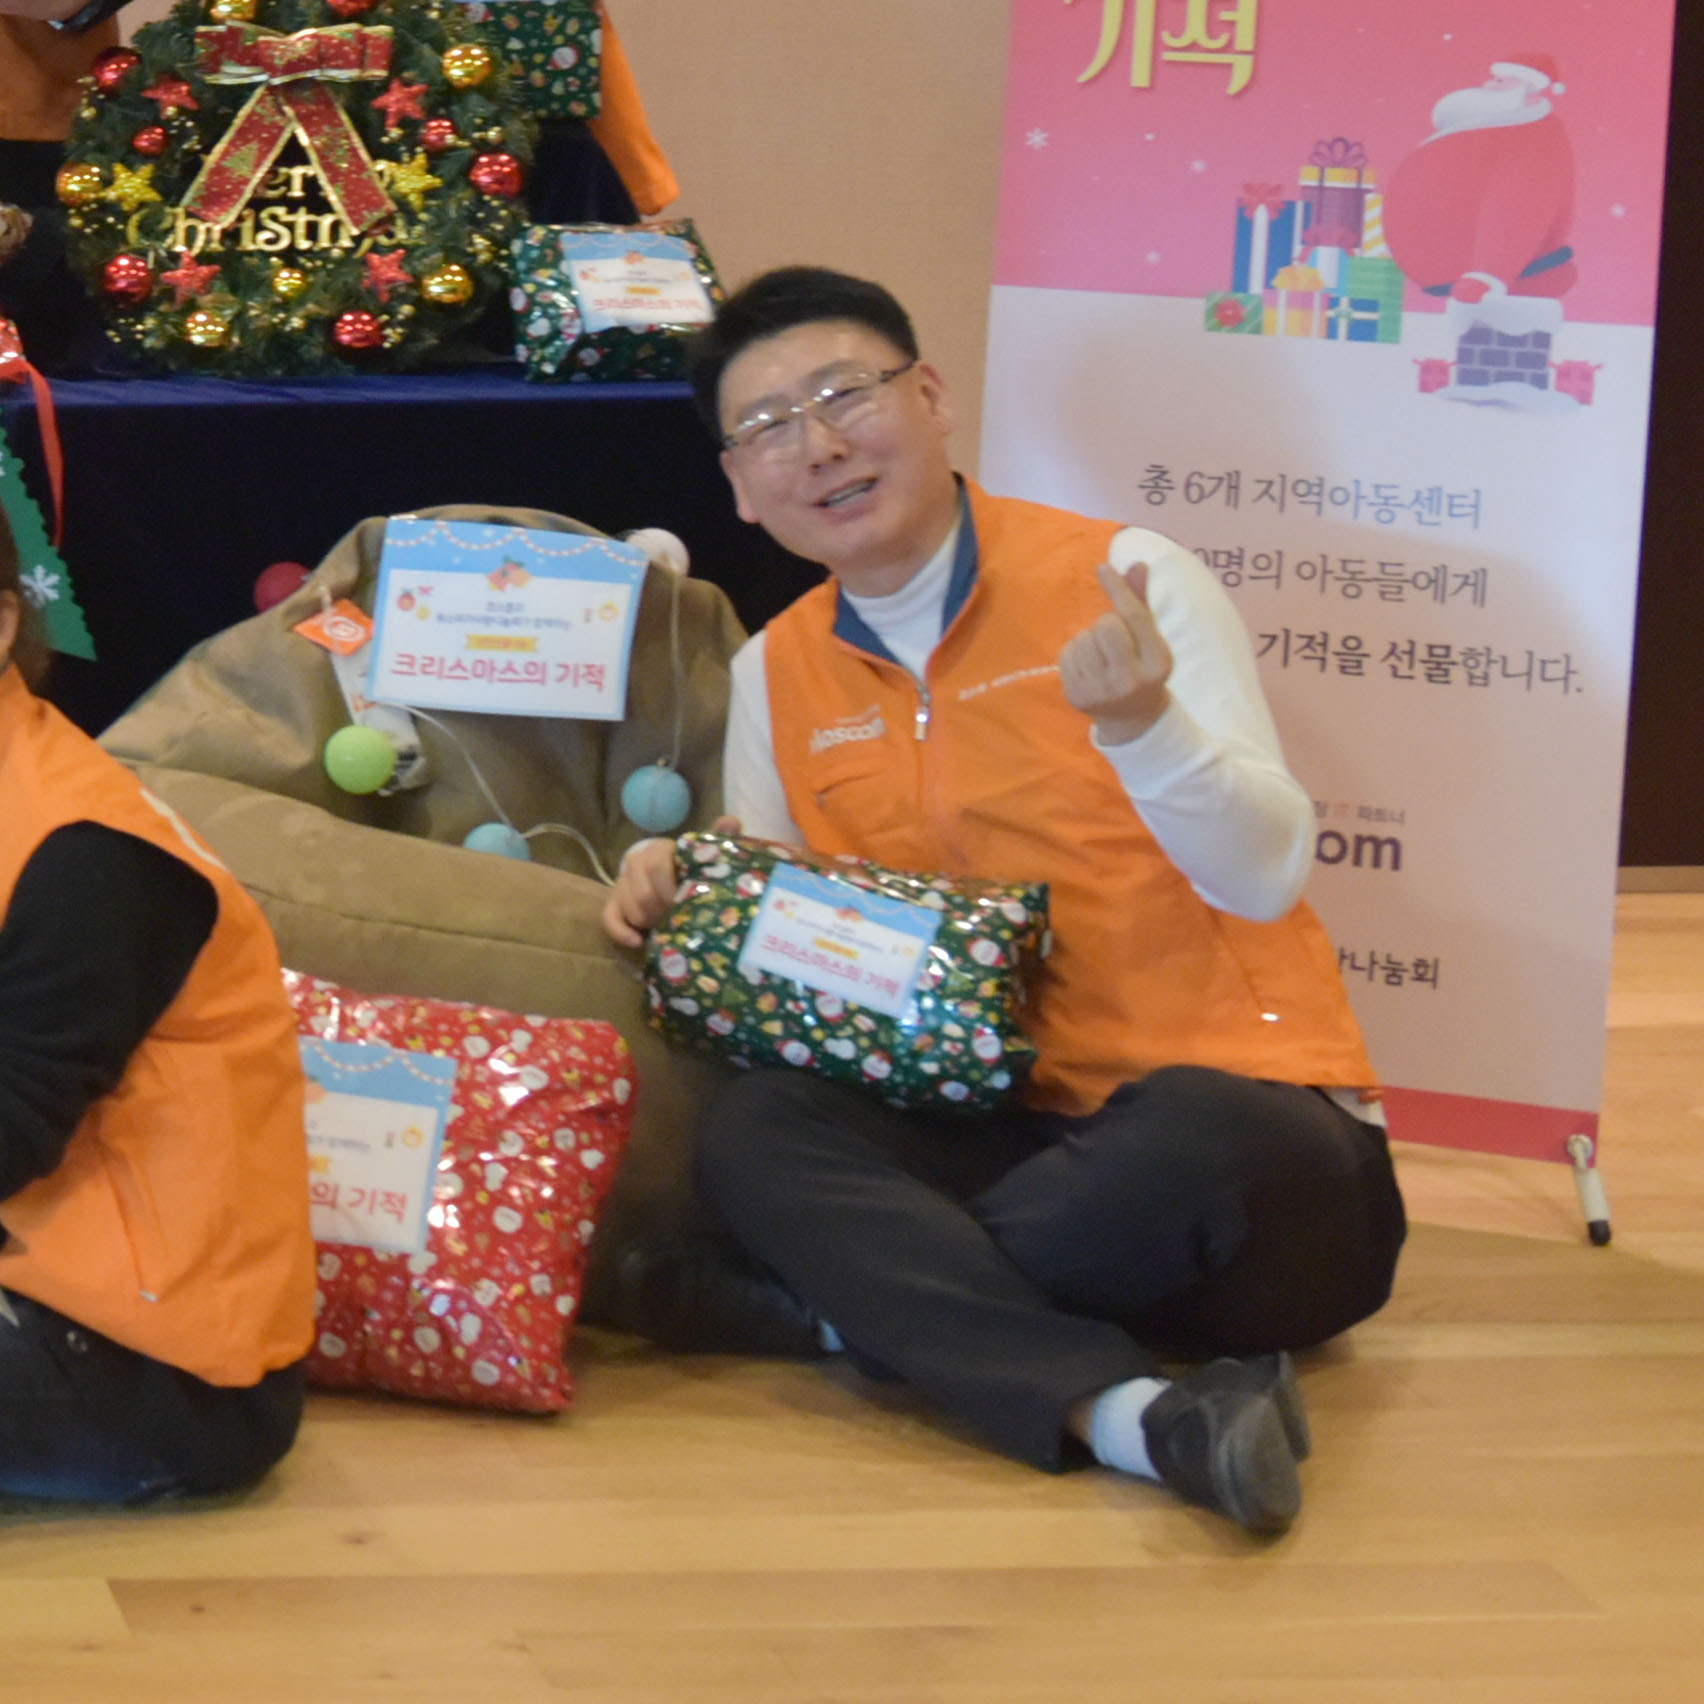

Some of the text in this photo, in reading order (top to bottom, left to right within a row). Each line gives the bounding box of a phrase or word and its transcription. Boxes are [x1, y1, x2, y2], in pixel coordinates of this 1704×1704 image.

[1137, 464, 1482, 530] 총 6개 지역아동센터
[1192, 547, 1489, 609] 명의 아동들에게
[392, 653, 607, 692] 크리스마스의 기적
[1256, 627, 1584, 695] 기적을 선물합니다.
[348, 1187, 408, 1225] 기적
